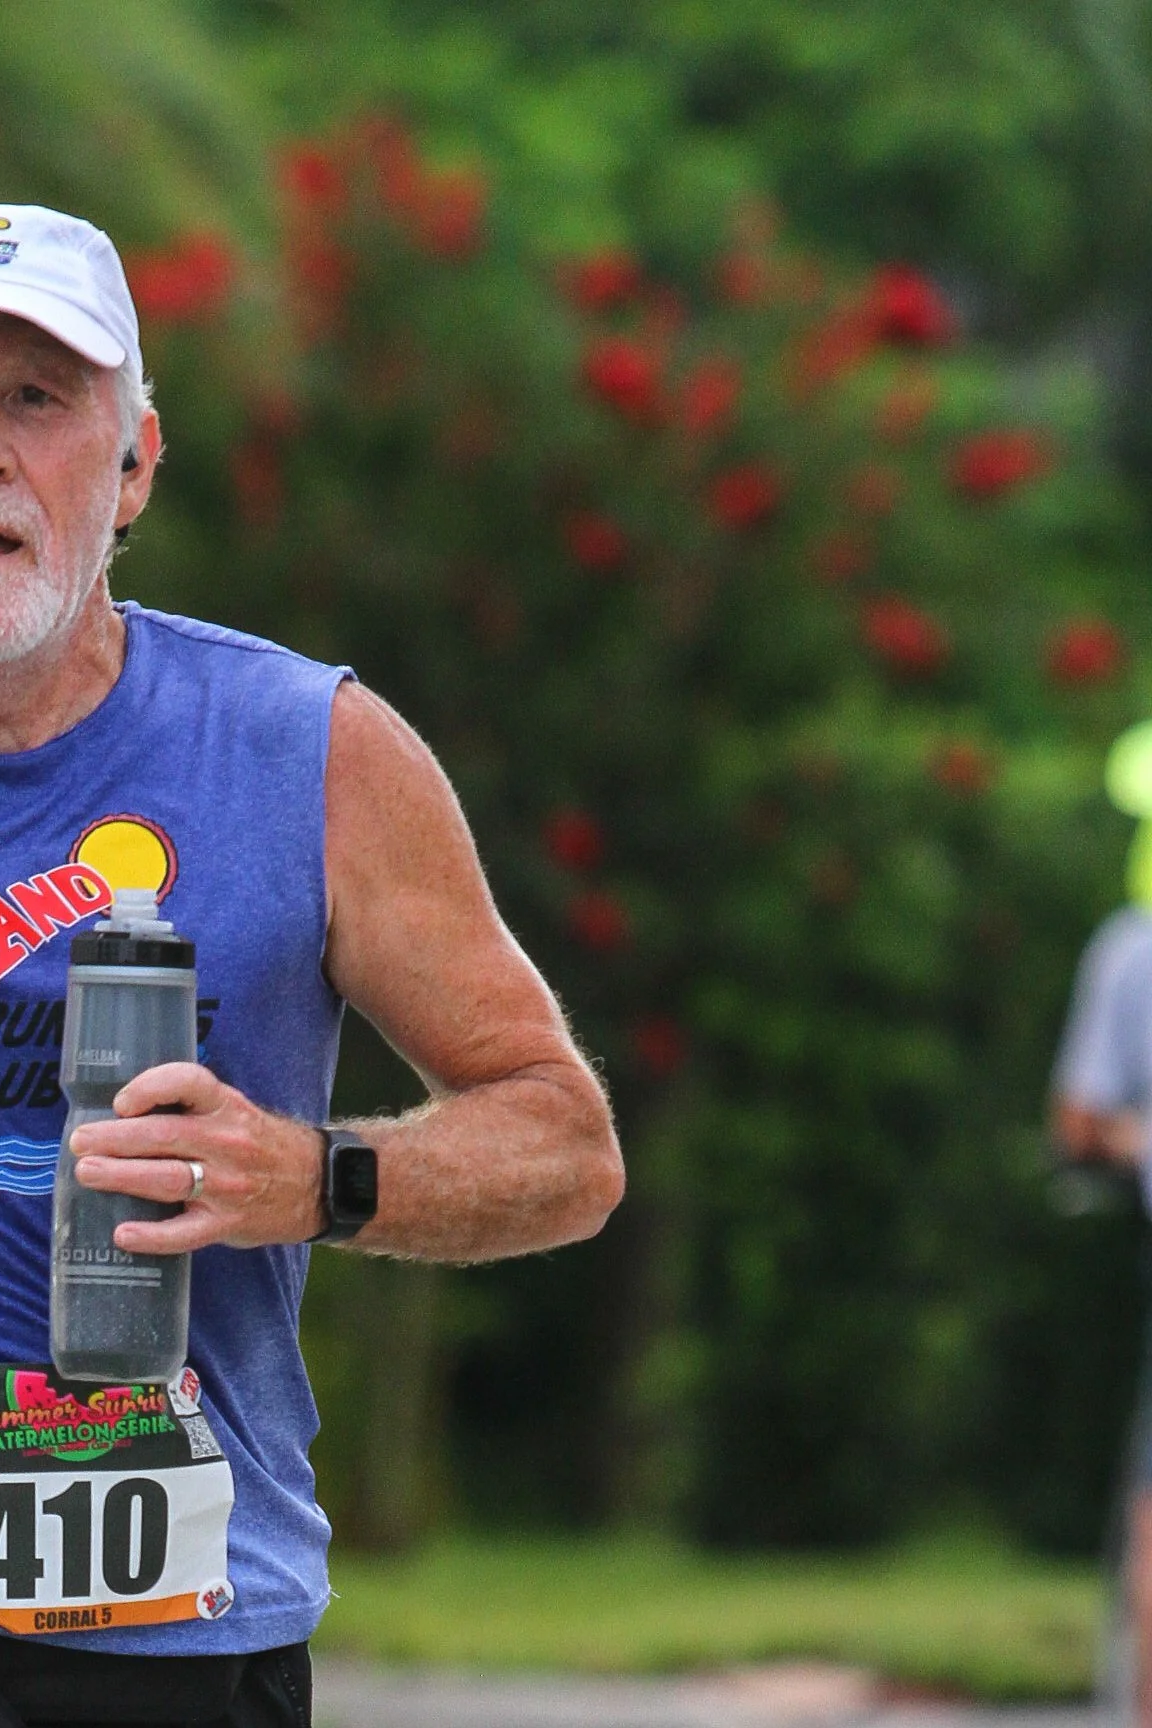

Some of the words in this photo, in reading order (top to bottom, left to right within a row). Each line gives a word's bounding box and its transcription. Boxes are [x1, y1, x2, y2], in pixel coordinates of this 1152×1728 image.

[59, 1247, 134, 1264] ODIUM
[33, 1609, 98, 1630] CORRAL
[101, 1606, 113, 1624] 5
